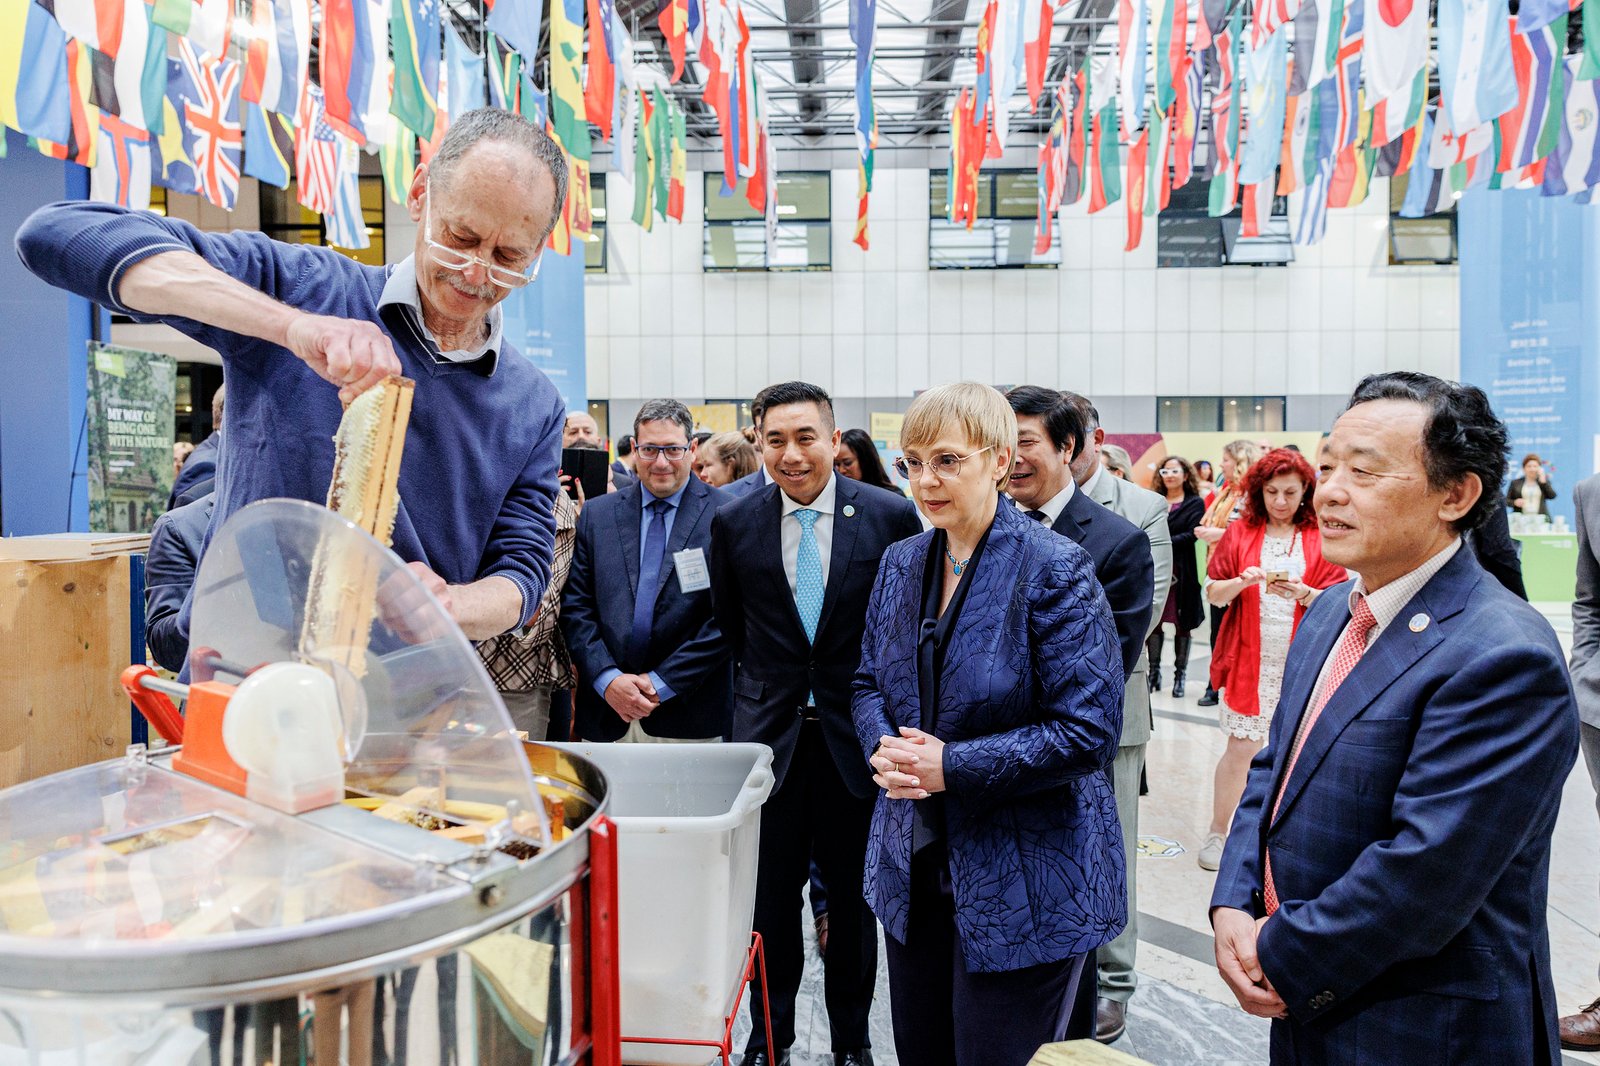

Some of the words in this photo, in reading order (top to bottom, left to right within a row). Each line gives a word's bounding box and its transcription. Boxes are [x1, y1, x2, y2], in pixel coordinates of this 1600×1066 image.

[107, 408, 122, 420] MY
[123, 409, 143, 422] WAY
[143, 410, 156, 423] OF
[108, 421, 136, 433] BEING
[137, 423, 156, 435] ONE
[108, 434, 134, 447] WITH
